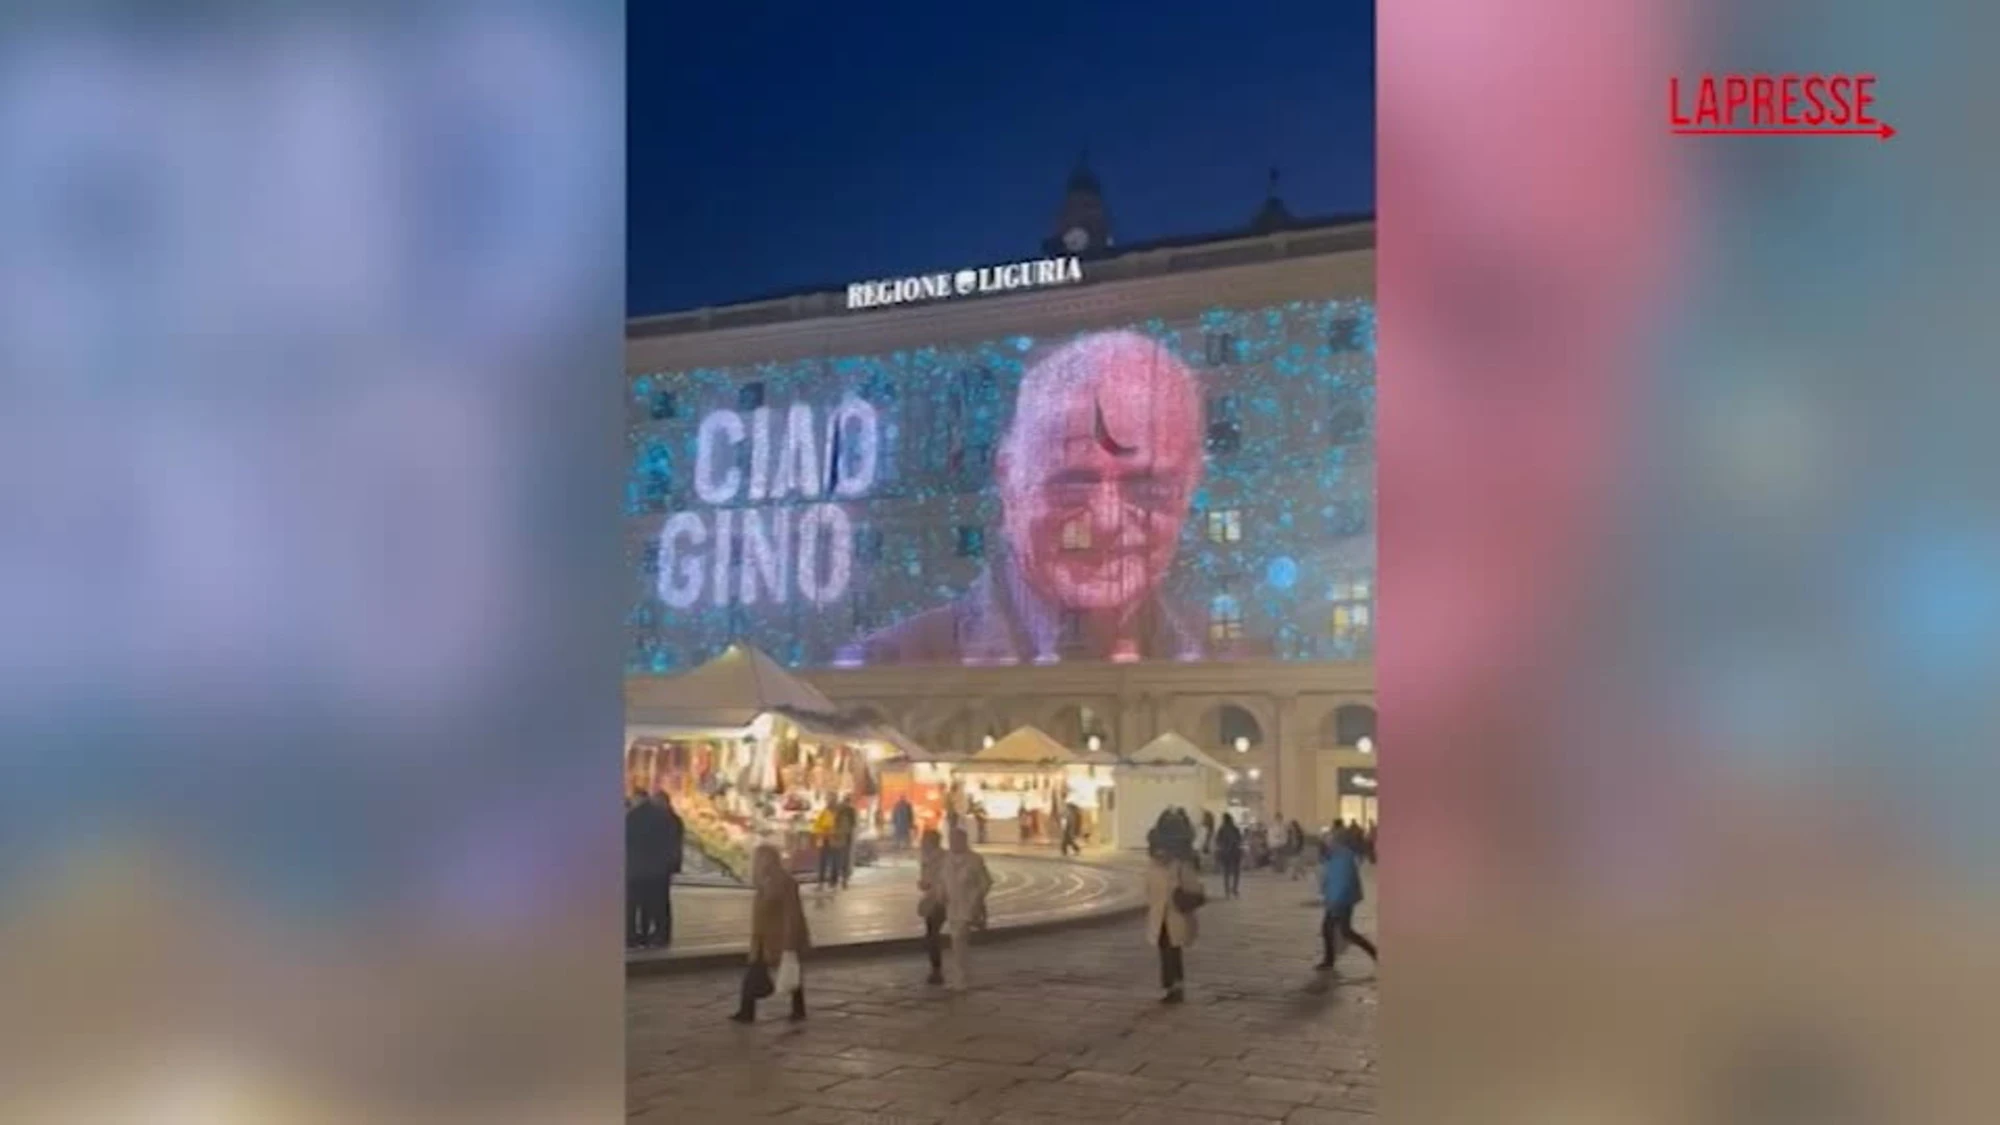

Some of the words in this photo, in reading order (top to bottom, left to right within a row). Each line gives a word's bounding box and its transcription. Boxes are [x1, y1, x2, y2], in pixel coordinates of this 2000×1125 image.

[847, 272, 952, 308] REGIONE
[978, 256, 1083, 291] LIGURIA
[694, 397, 877, 503] CIAO
[657, 503, 852, 608] GINO
